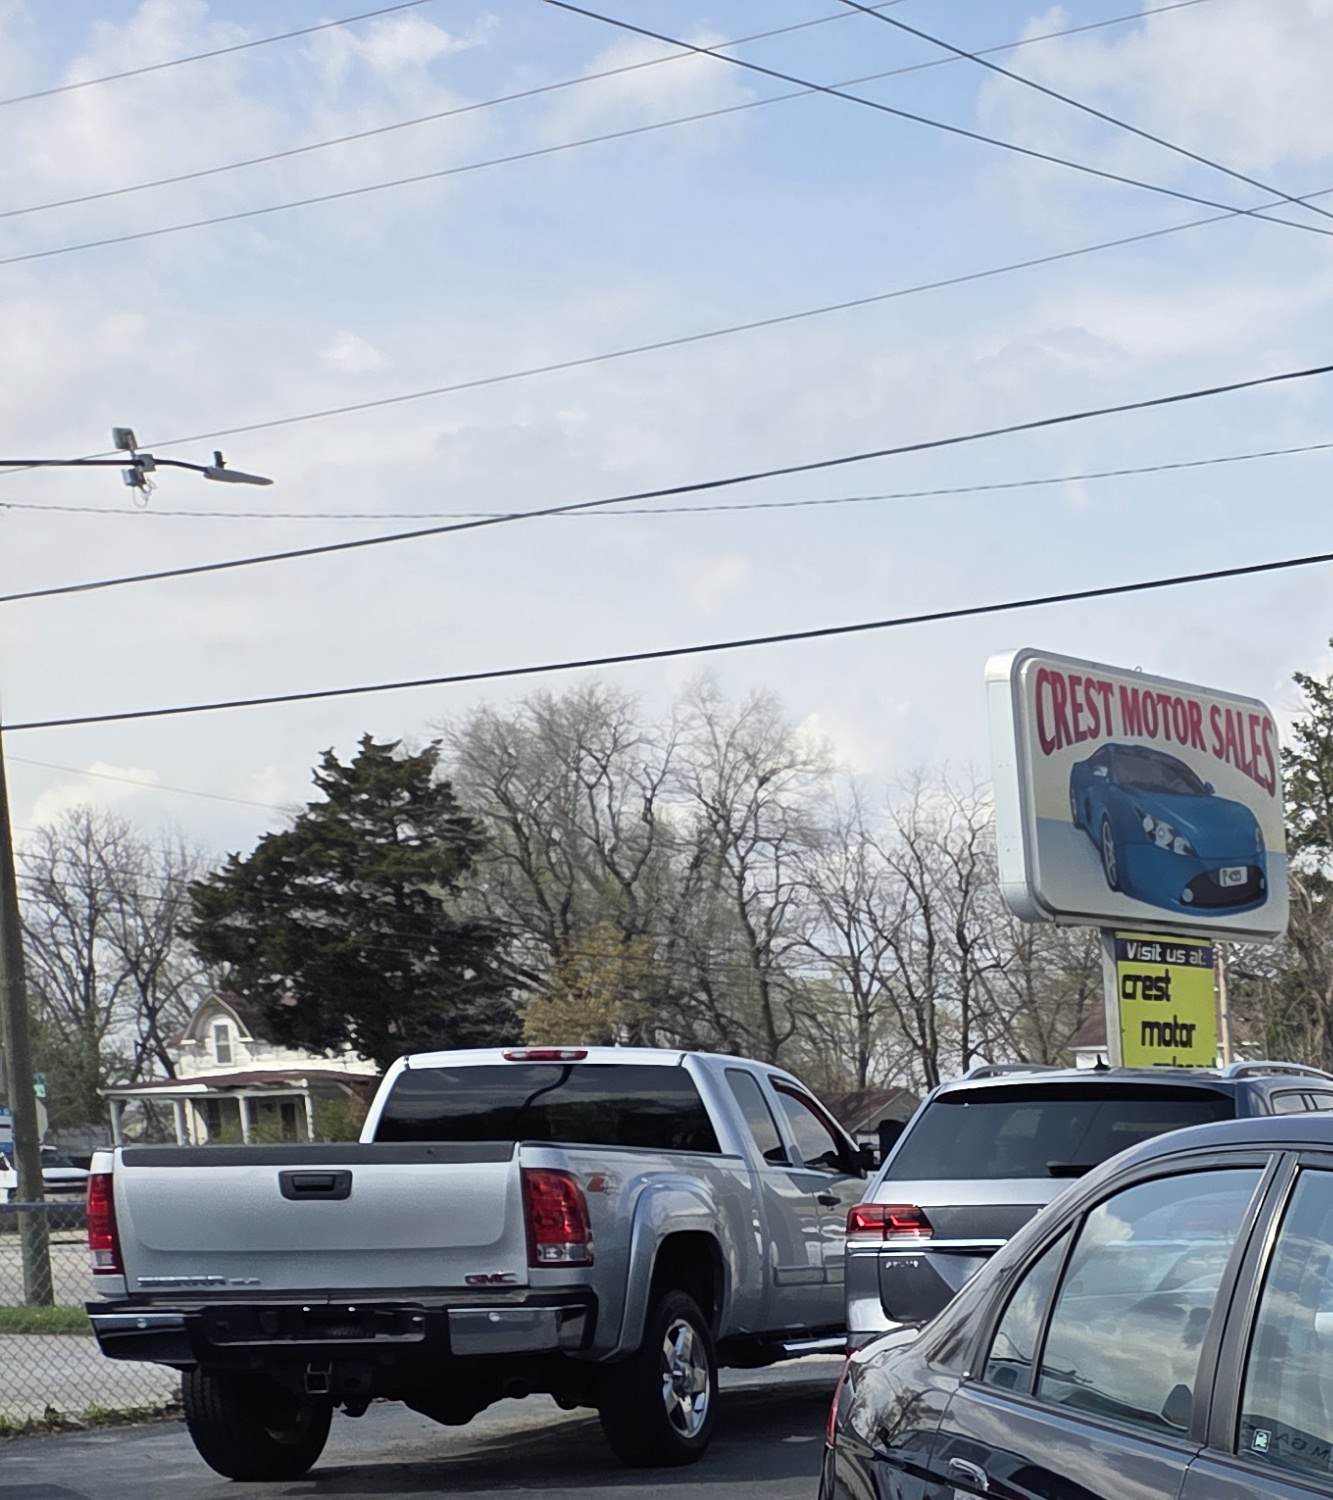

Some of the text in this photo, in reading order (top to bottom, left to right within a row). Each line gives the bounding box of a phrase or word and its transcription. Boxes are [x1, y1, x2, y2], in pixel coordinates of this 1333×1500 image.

[1035, 667, 1276, 798] CREST MOTOR SALES
[1126, 941, 1162, 961] Visit
[1166, 948, 1186, 963] us
[1121, 968, 1172, 1003] crest
[1141, 1014, 1196, 1049] motor
